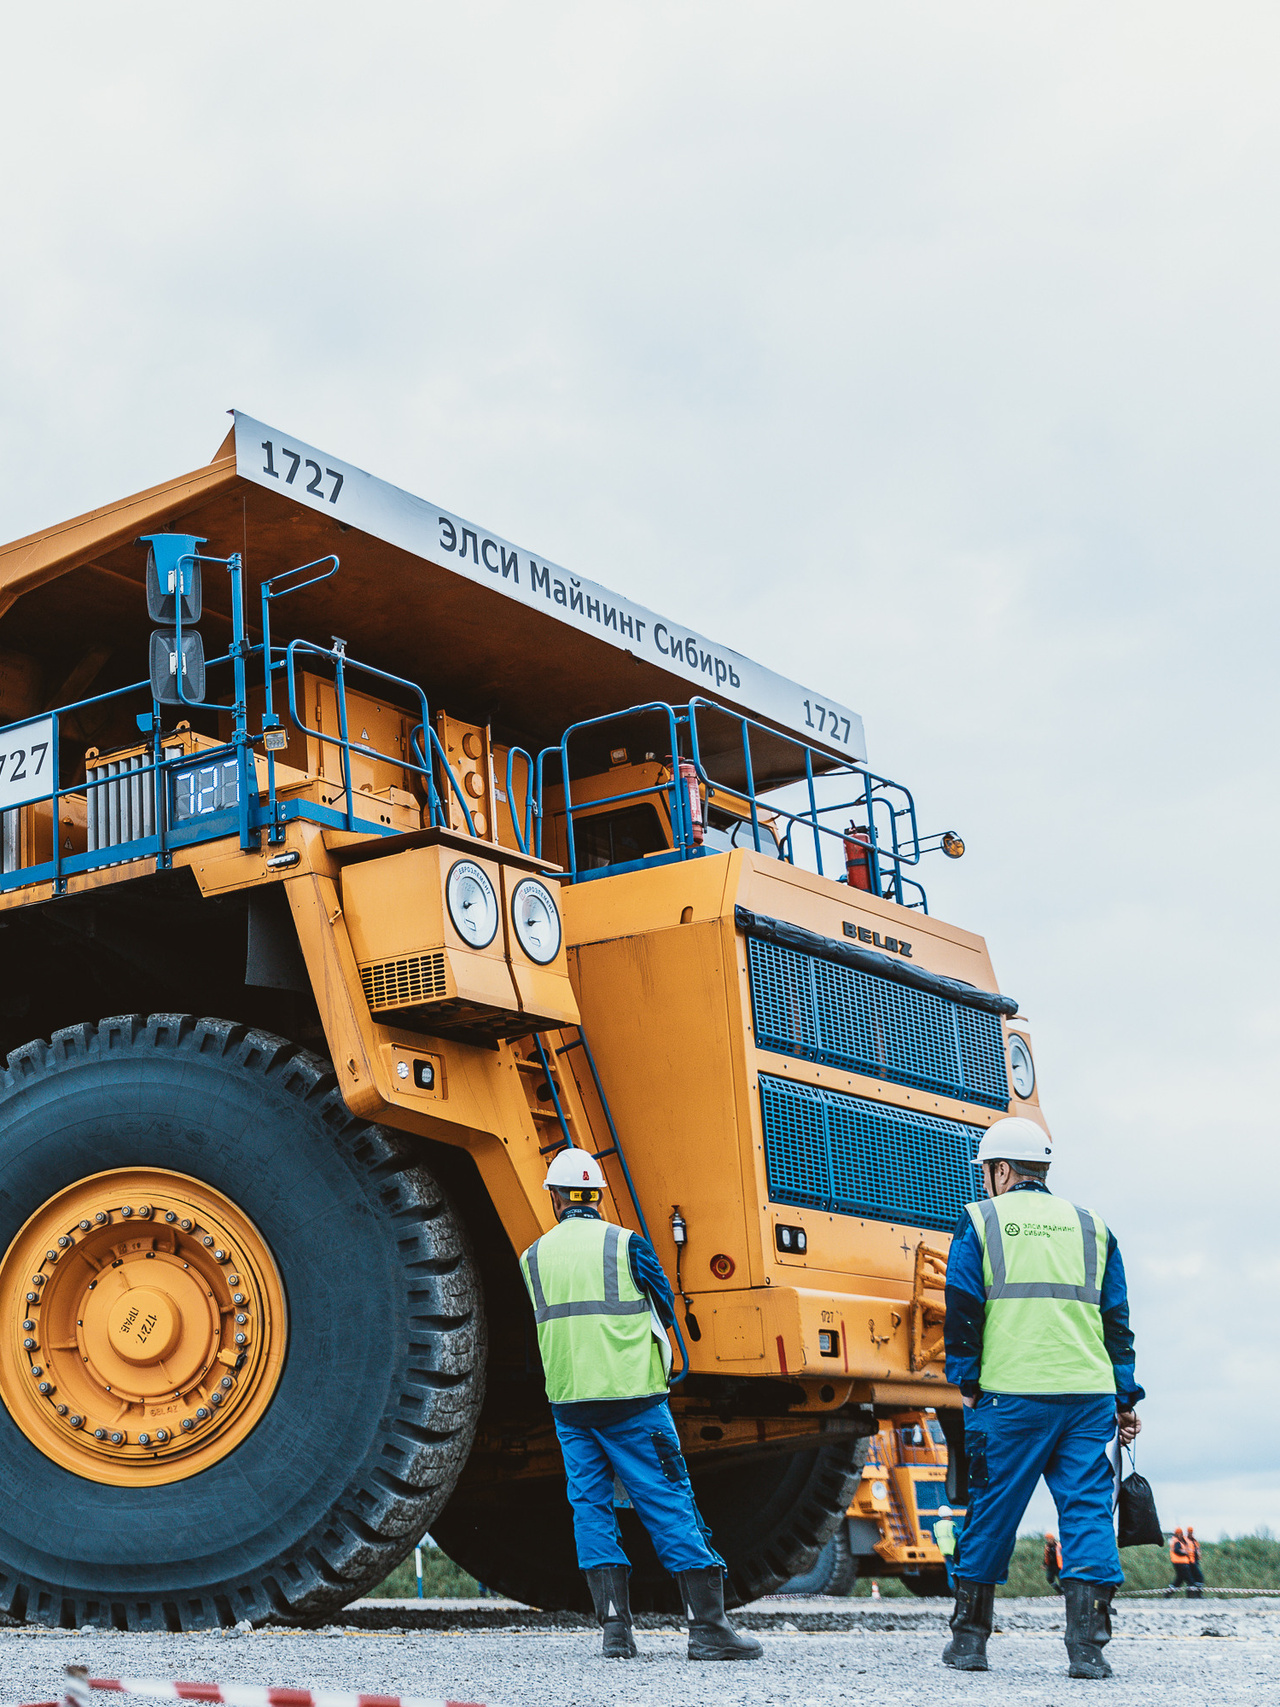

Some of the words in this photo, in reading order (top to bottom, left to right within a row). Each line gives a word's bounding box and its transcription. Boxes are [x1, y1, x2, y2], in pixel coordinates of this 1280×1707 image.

[261, 440, 344, 504] 1727
[438, 516, 520, 585] ЭЛСИ
[529, 560, 646, 643] Майнинг
[653, 622, 741, 689] Сибирь
[803, 699, 852, 745] 1727
[841, 920, 913, 958] BELAZ
[1022, 1222, 1041, 1230] ЭЛСИ
[1042, 1223, 1075, 1233] МАЙНИНГ
[1023, 1230, 1051, 1239] СИБИРЬ
[136, 1314, 158, 1344] 1727
